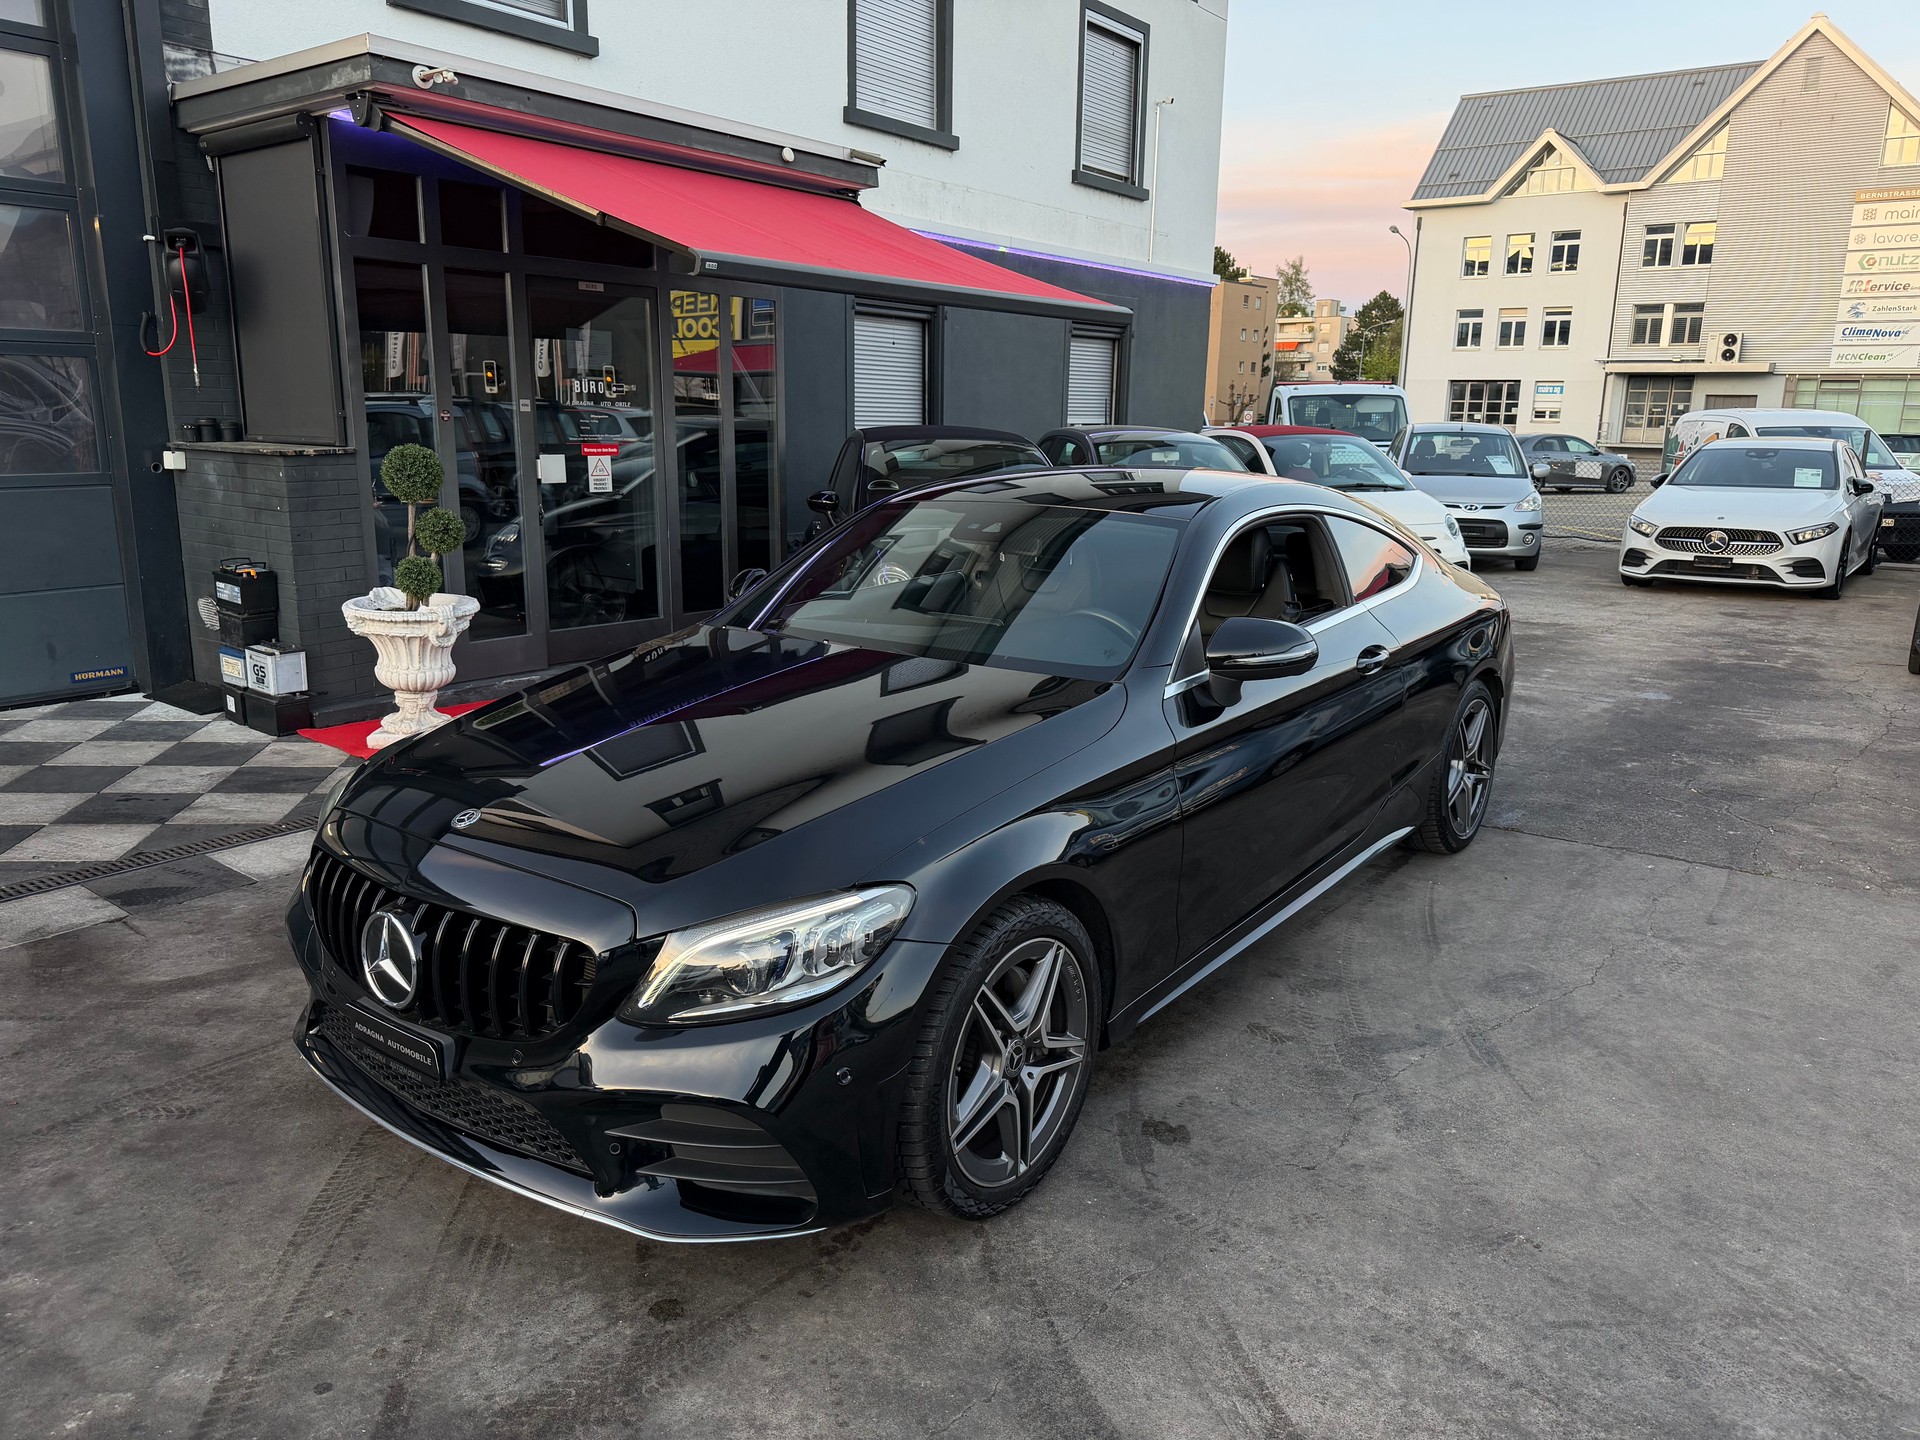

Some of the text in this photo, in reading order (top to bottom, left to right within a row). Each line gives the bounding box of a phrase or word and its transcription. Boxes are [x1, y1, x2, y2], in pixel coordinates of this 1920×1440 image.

[1861, 190, 1920, 199] BERNSTRASSE
[1873, 233, 1920, 244] lavore
[1842, 327, 1901, 337] ClimaNova
[1836, 353, 1886, 361] HCNClean
[574, 379, 604, 394] BÜRO
[252, 663, 267, 679] GS
[355, 1021, 432, 1066] ADRAGNA AUTOMOBILE
